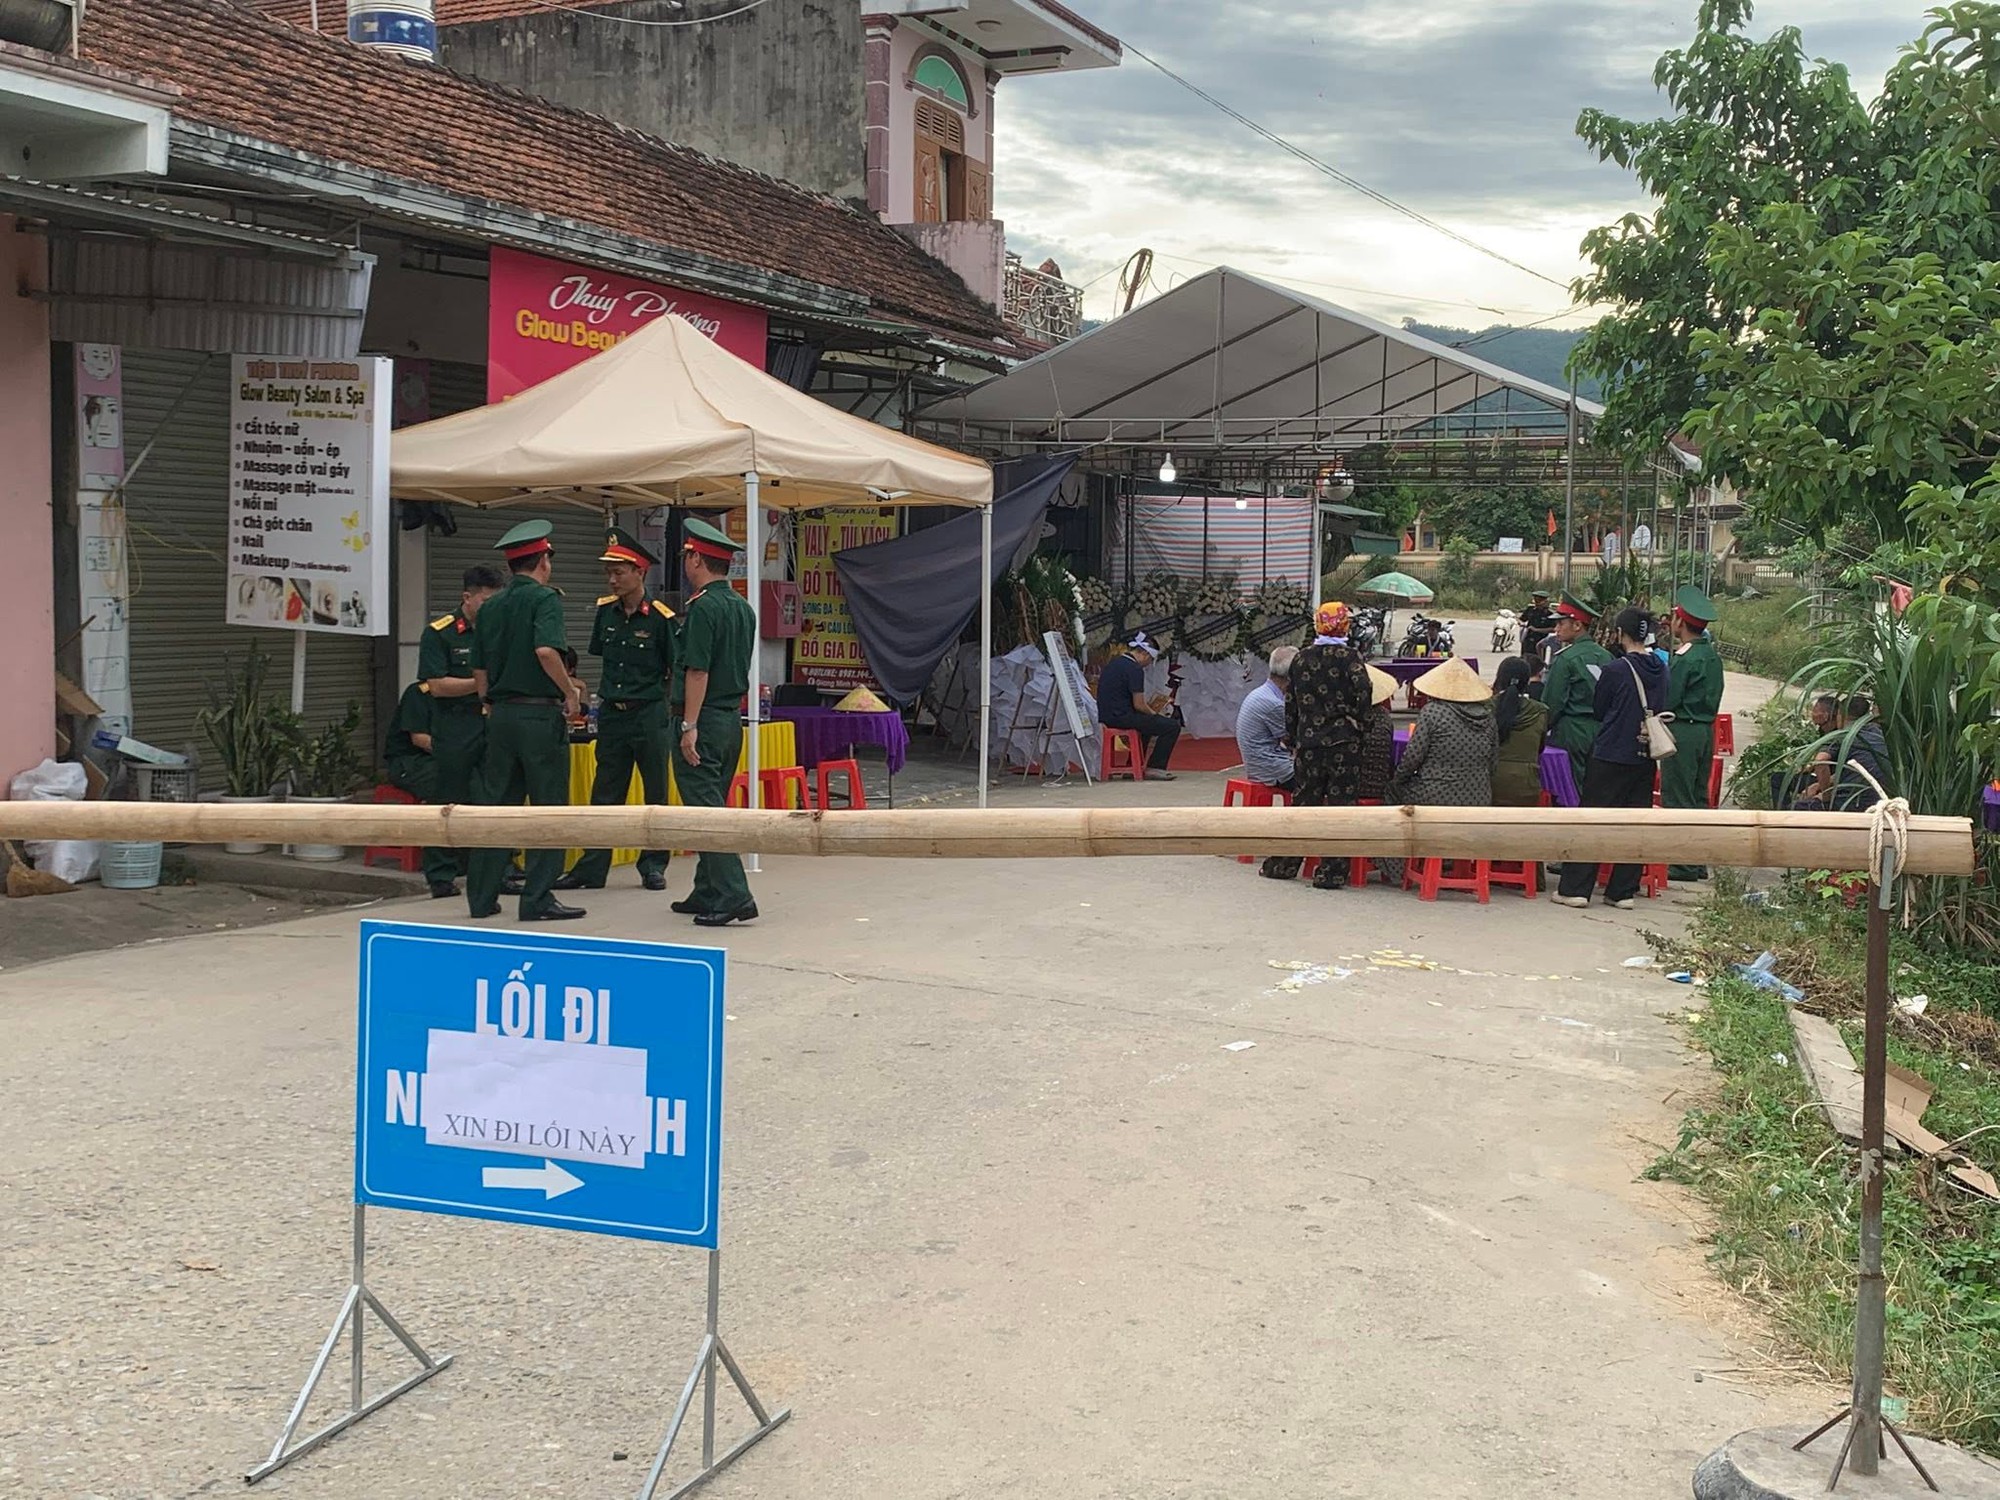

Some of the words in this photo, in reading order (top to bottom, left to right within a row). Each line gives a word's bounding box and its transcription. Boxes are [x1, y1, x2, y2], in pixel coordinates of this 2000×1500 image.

[515, 309, 570, 344] Glow
[240, 382, 265, 401] Glow
[267, 383, 301, 407] Beauty
[304, 384, 331, 403] Salon
[335, 387, 342, 404] &
[346, 386, 364, 409] Spa
[245, 416, 262, 434] Cắt
[265, 421, 282, 435] tóc
[284, 422, 299, 436] nữ
[244, 440, 282, 457] Nhuộm
[294, 437, 315, 455] uốn
[326, 442, 340, 459] ép
[243, 460, 292, 476] Massage
[310, 462, 327, 476] vai
[329, 462, 350, 479] gáy
[243, 479, 292, 494] Massage
[294, 480, 316, 497] mặt
[263, 497, 277, 511] mi
[265, 516, 283, 532] gót
[286, 517, 313, 532] chân
[241, 535, 264, 548] Nail
[805, 525, 829, 556] VALY
[241, 553, 290, 570] Makeup
[825, 570, 845, 596] TH
[824, 640, 845, 660] GIA
[475, 961, 547, 1039] LỐI
[562, 986, 610, 1046] ĐI
[443, 1113, 487, 1139] XIN
[494, 1120, 520, 1143] ĐI
[529, 1120, 570, 1149] LỐI
[578, 1126, 636, 1156] NÀY
